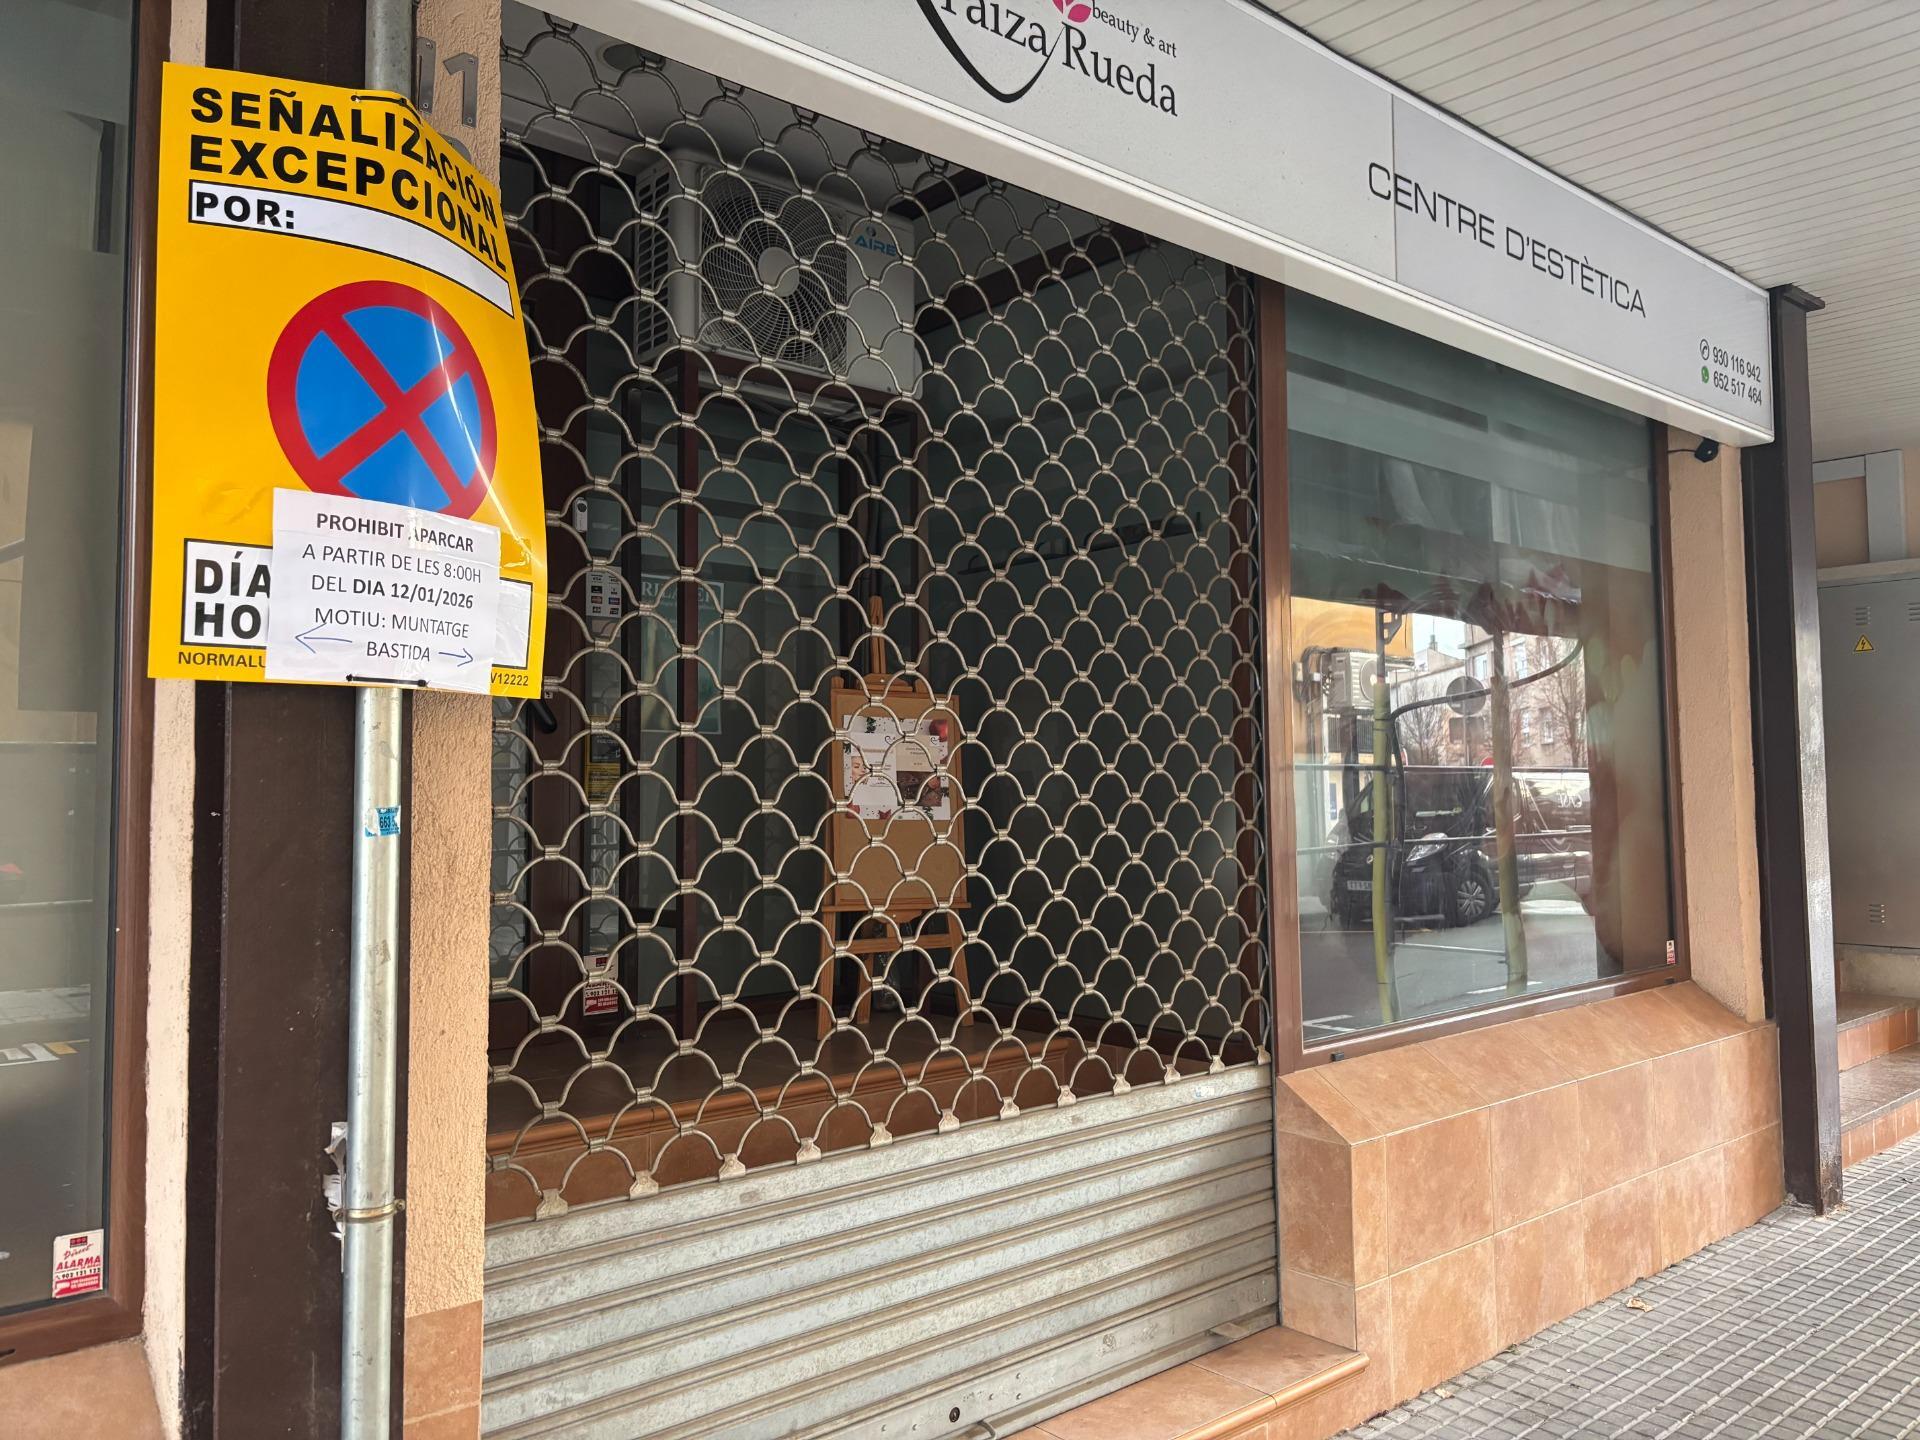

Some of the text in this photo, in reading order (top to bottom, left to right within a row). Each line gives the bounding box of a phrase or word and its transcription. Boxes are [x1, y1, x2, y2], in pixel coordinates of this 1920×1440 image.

[1092, 0, 1177, 58] beauty & art
[1061, 21, 1178, 117] Rueda
[191, 87, 497, 228] SEÑALIZACIÓN
[190, 135, 506, 272] EXCEPCIONAL
[196, 191, 295, 229] POR:
[1368, 162, 1647, 318] CENTRE D'ESTÈTICA
[1713, 346, 1761, 383] 930 116 942
[1713, 370, 1762, 406] 652 517 464
[316, 513, 404, 539] PROHIBIT
[302, 544, 482, 584] A PARTIR DE LES 8:00H
[312, 574, 474, 609] DEL DIA 12/01/2026
[315, 607, 470, 639] MOTIU: MUNTATGE
[366, 641, 431, 662] BASTIDA
[56, 1255, 101, 1271] ALARMA
